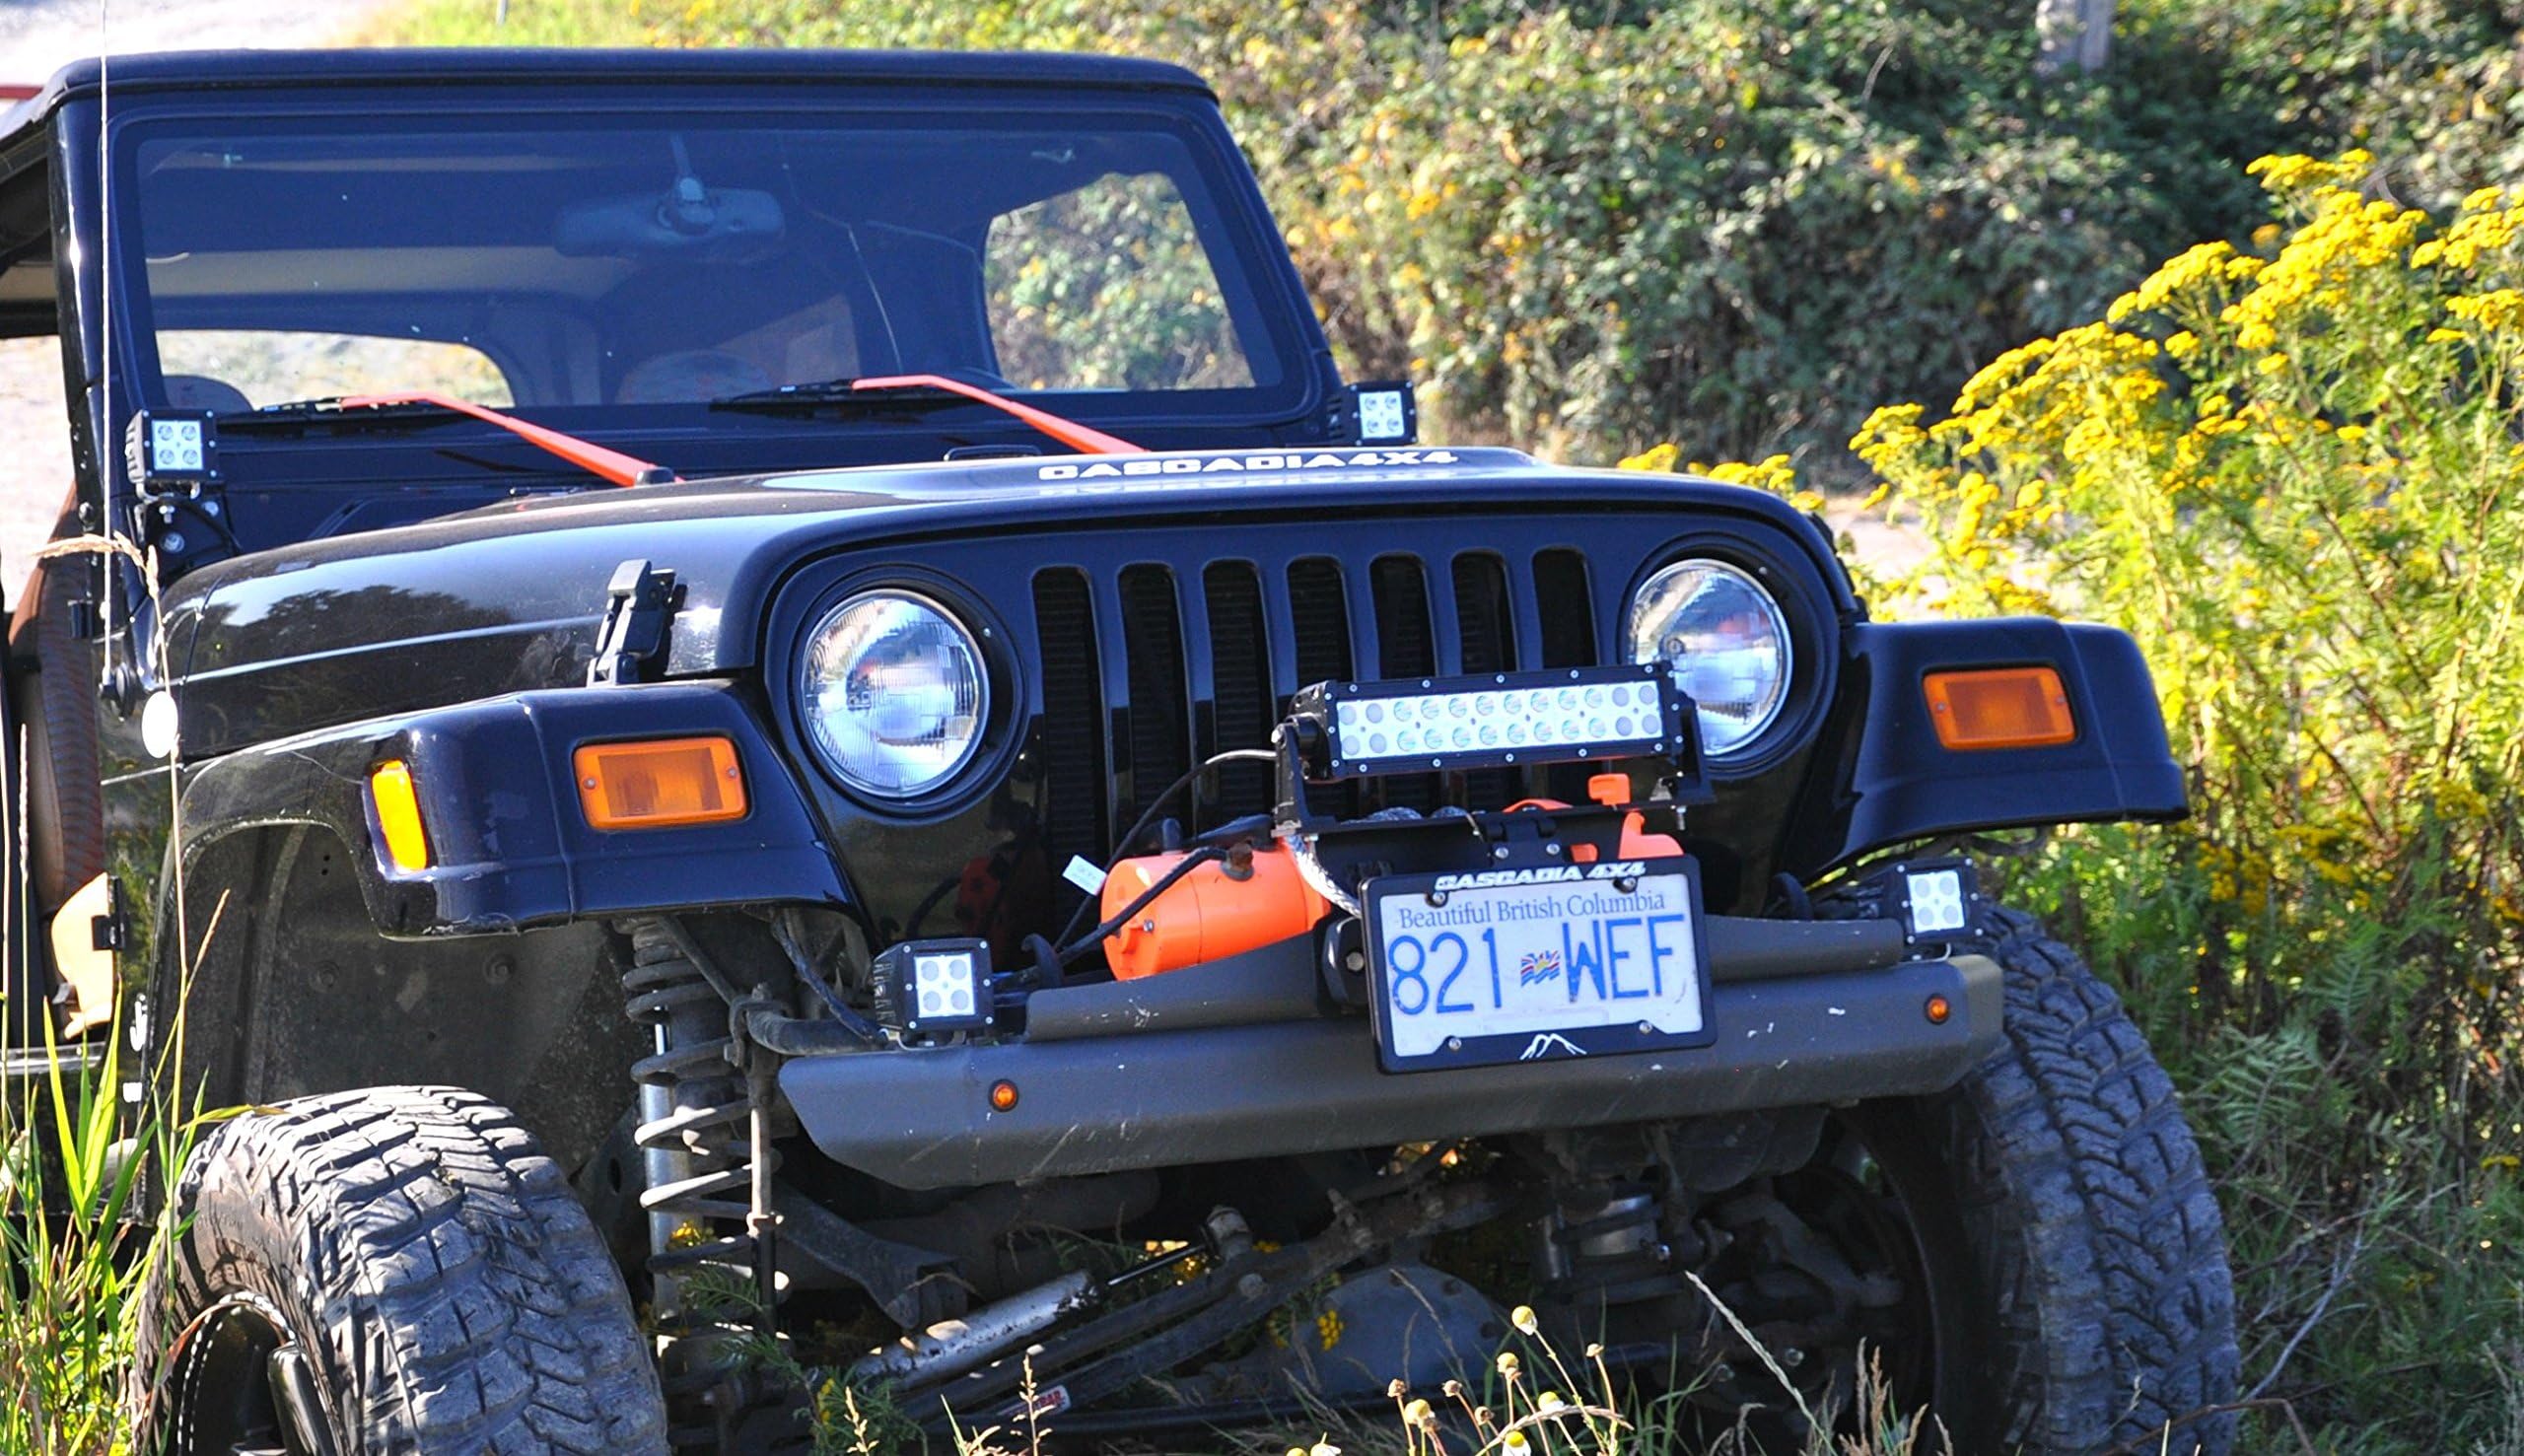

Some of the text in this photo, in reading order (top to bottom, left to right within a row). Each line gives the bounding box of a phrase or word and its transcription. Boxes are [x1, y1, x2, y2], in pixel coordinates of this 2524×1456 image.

[1435, 862, 1647, 891] CASCADIA 4X4
[1398, 890, 1665, 930] Beautiful British Columbia
[1387, 914, 1685, 1016] 821 WEF
